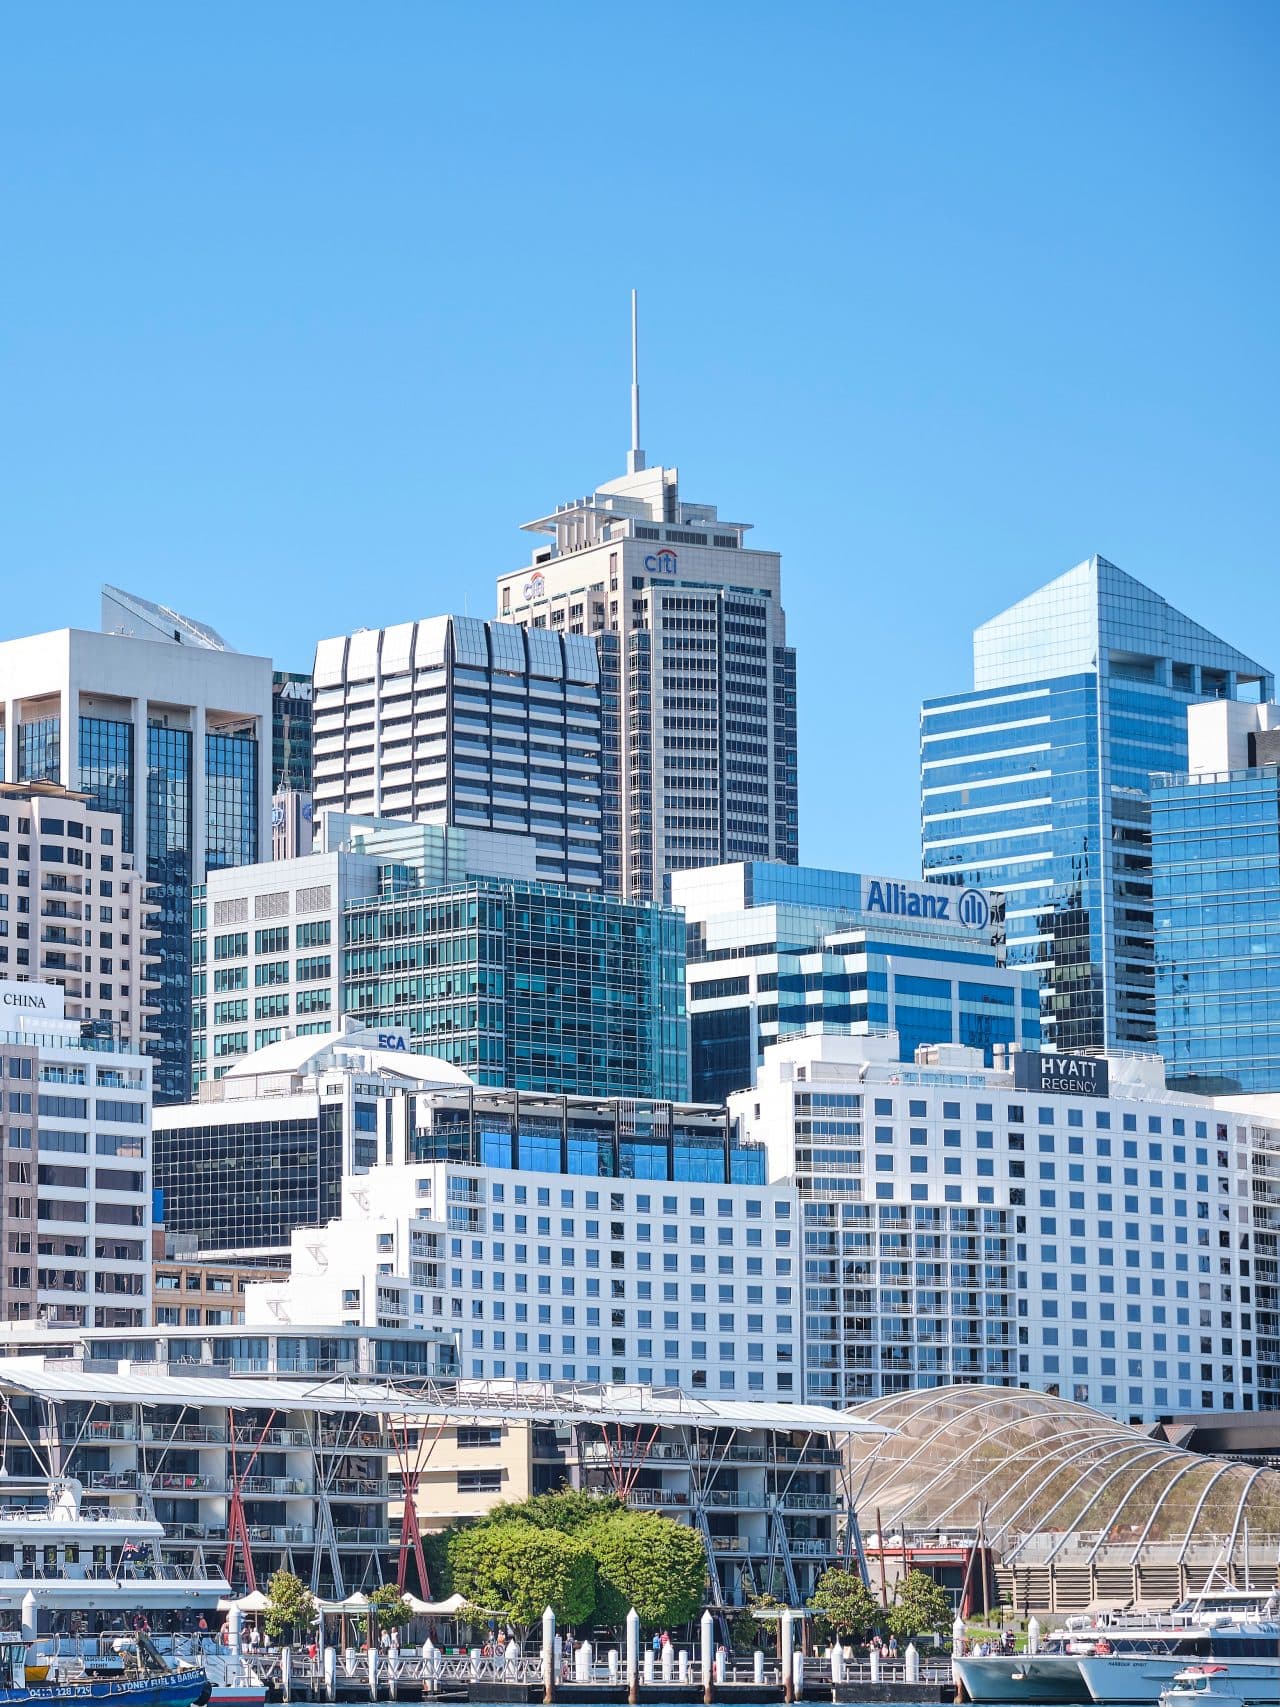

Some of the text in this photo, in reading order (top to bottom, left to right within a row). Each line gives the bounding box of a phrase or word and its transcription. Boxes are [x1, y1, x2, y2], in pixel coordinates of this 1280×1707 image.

[644, 551, 677, 574] citi
[867, 880, 950, 920] Allianz
[3, 993, 47, 1009] CHINA
[378, 1034, 406, 1050] ECA
[1041, 1058, 1097, 1078] HYATT
[1041, 1077, 1097, 1093] REGENCY
[117, 1680, 149, 1691] SYDNEY
